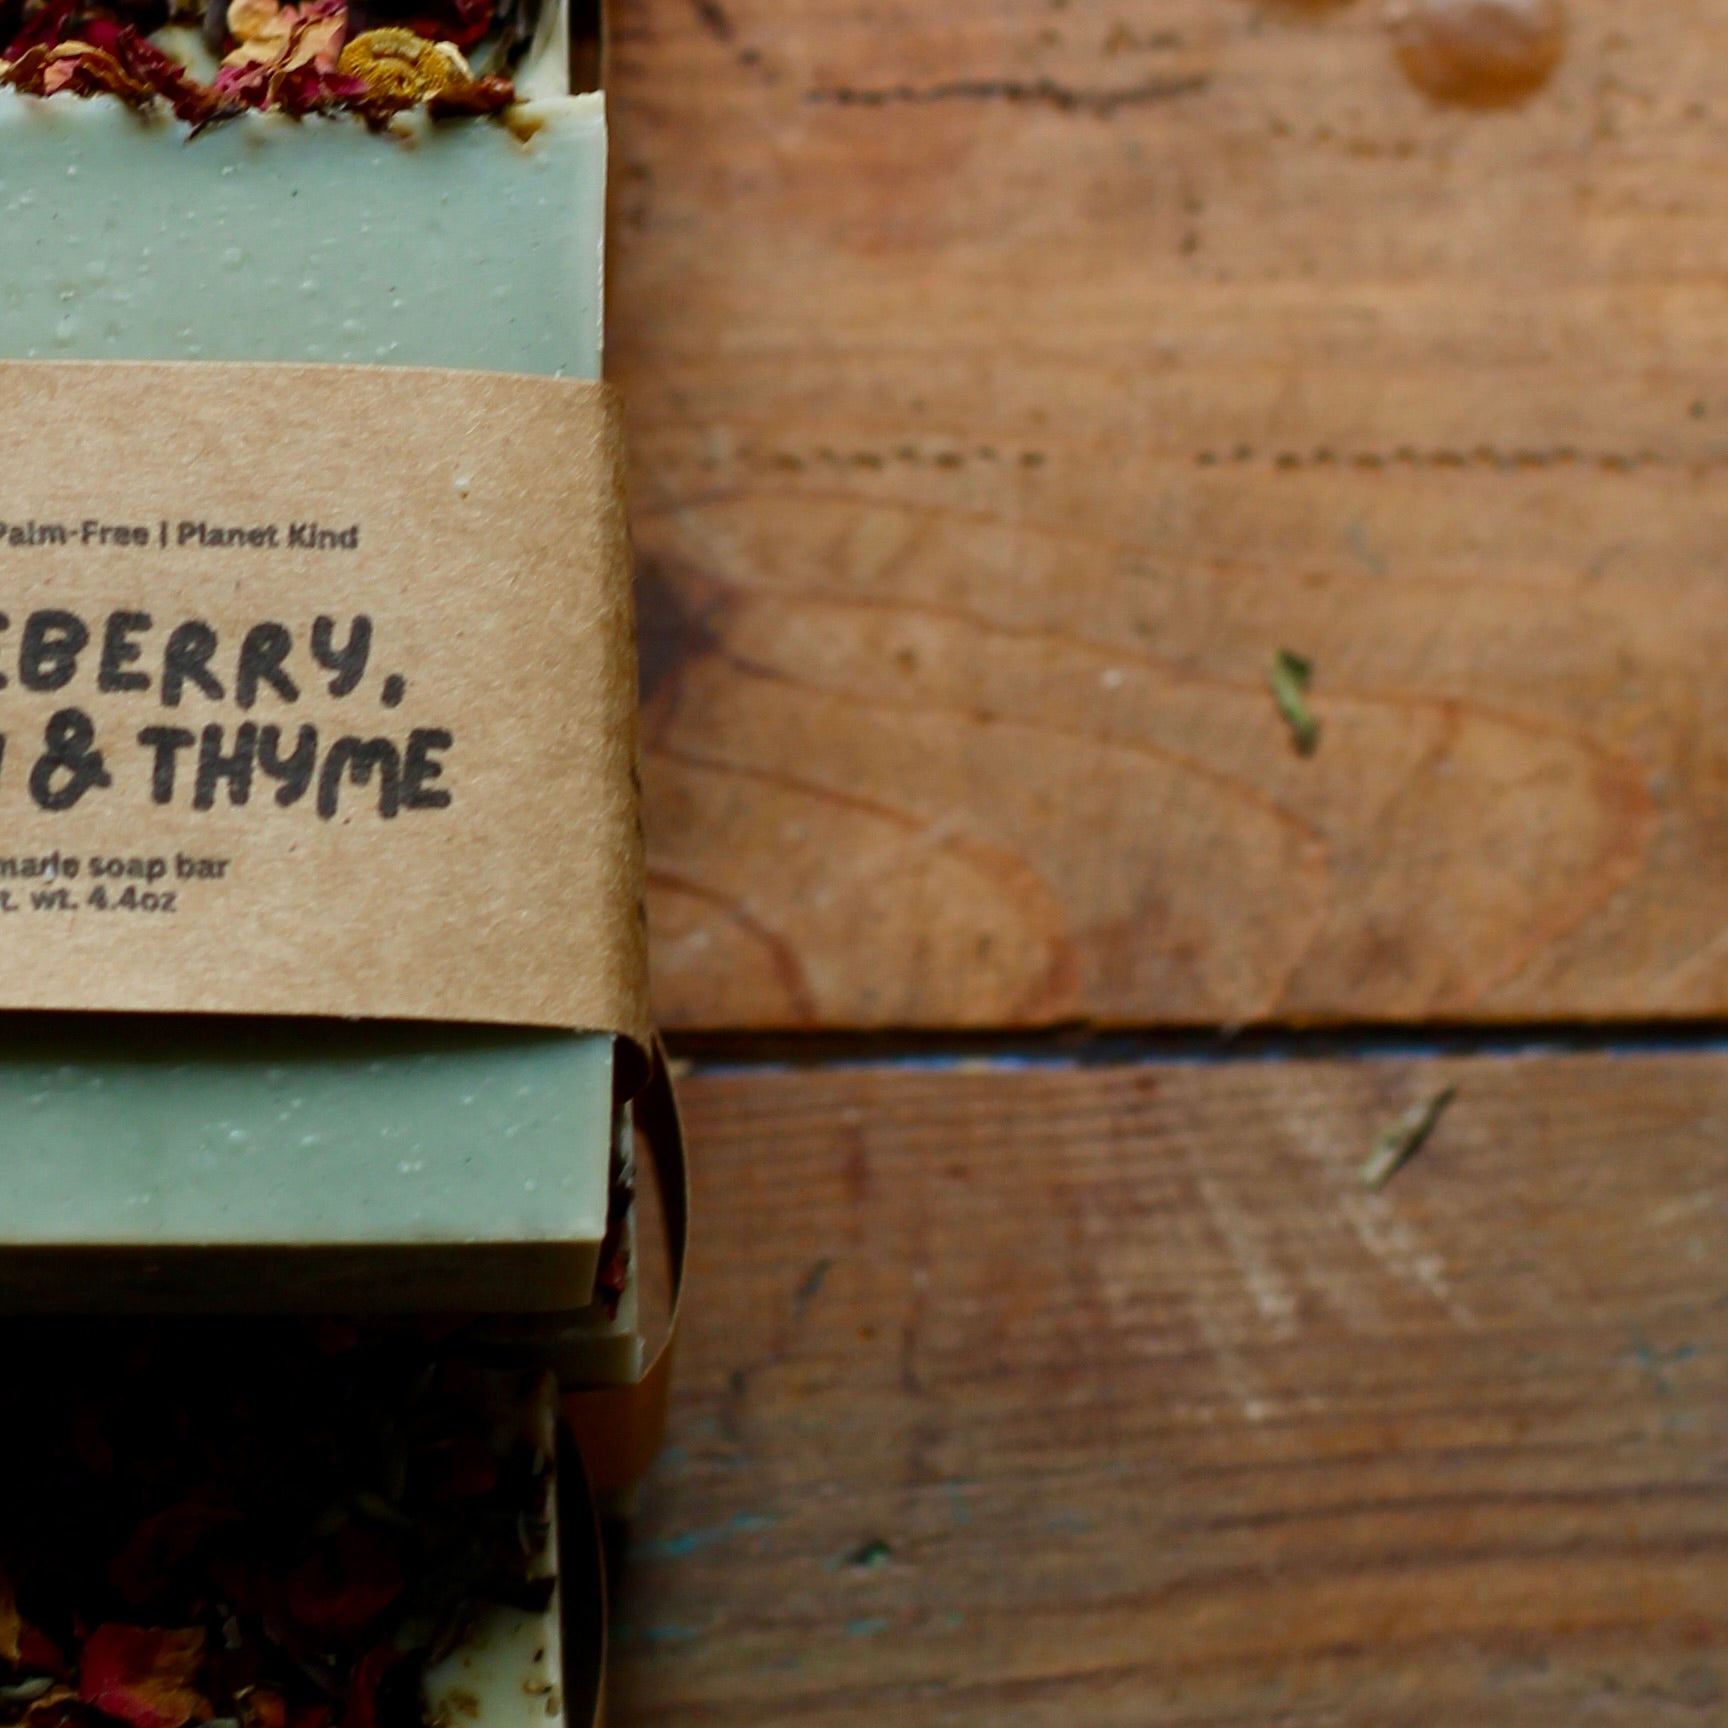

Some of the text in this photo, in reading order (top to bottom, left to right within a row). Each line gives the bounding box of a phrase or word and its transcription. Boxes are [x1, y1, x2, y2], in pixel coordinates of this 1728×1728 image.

[177, 521, 279, 549] Planet
[287, 522, 359, 551] Kind
[27, 706, 113, 814] &
[135, 722, 455, 822] THYME
[87, 855, 168, 886] soap
[175, 852, 231, 880] bar
[30, 887, 80, 912] wt.
[86, 884, 179, 914] 4.4oz
